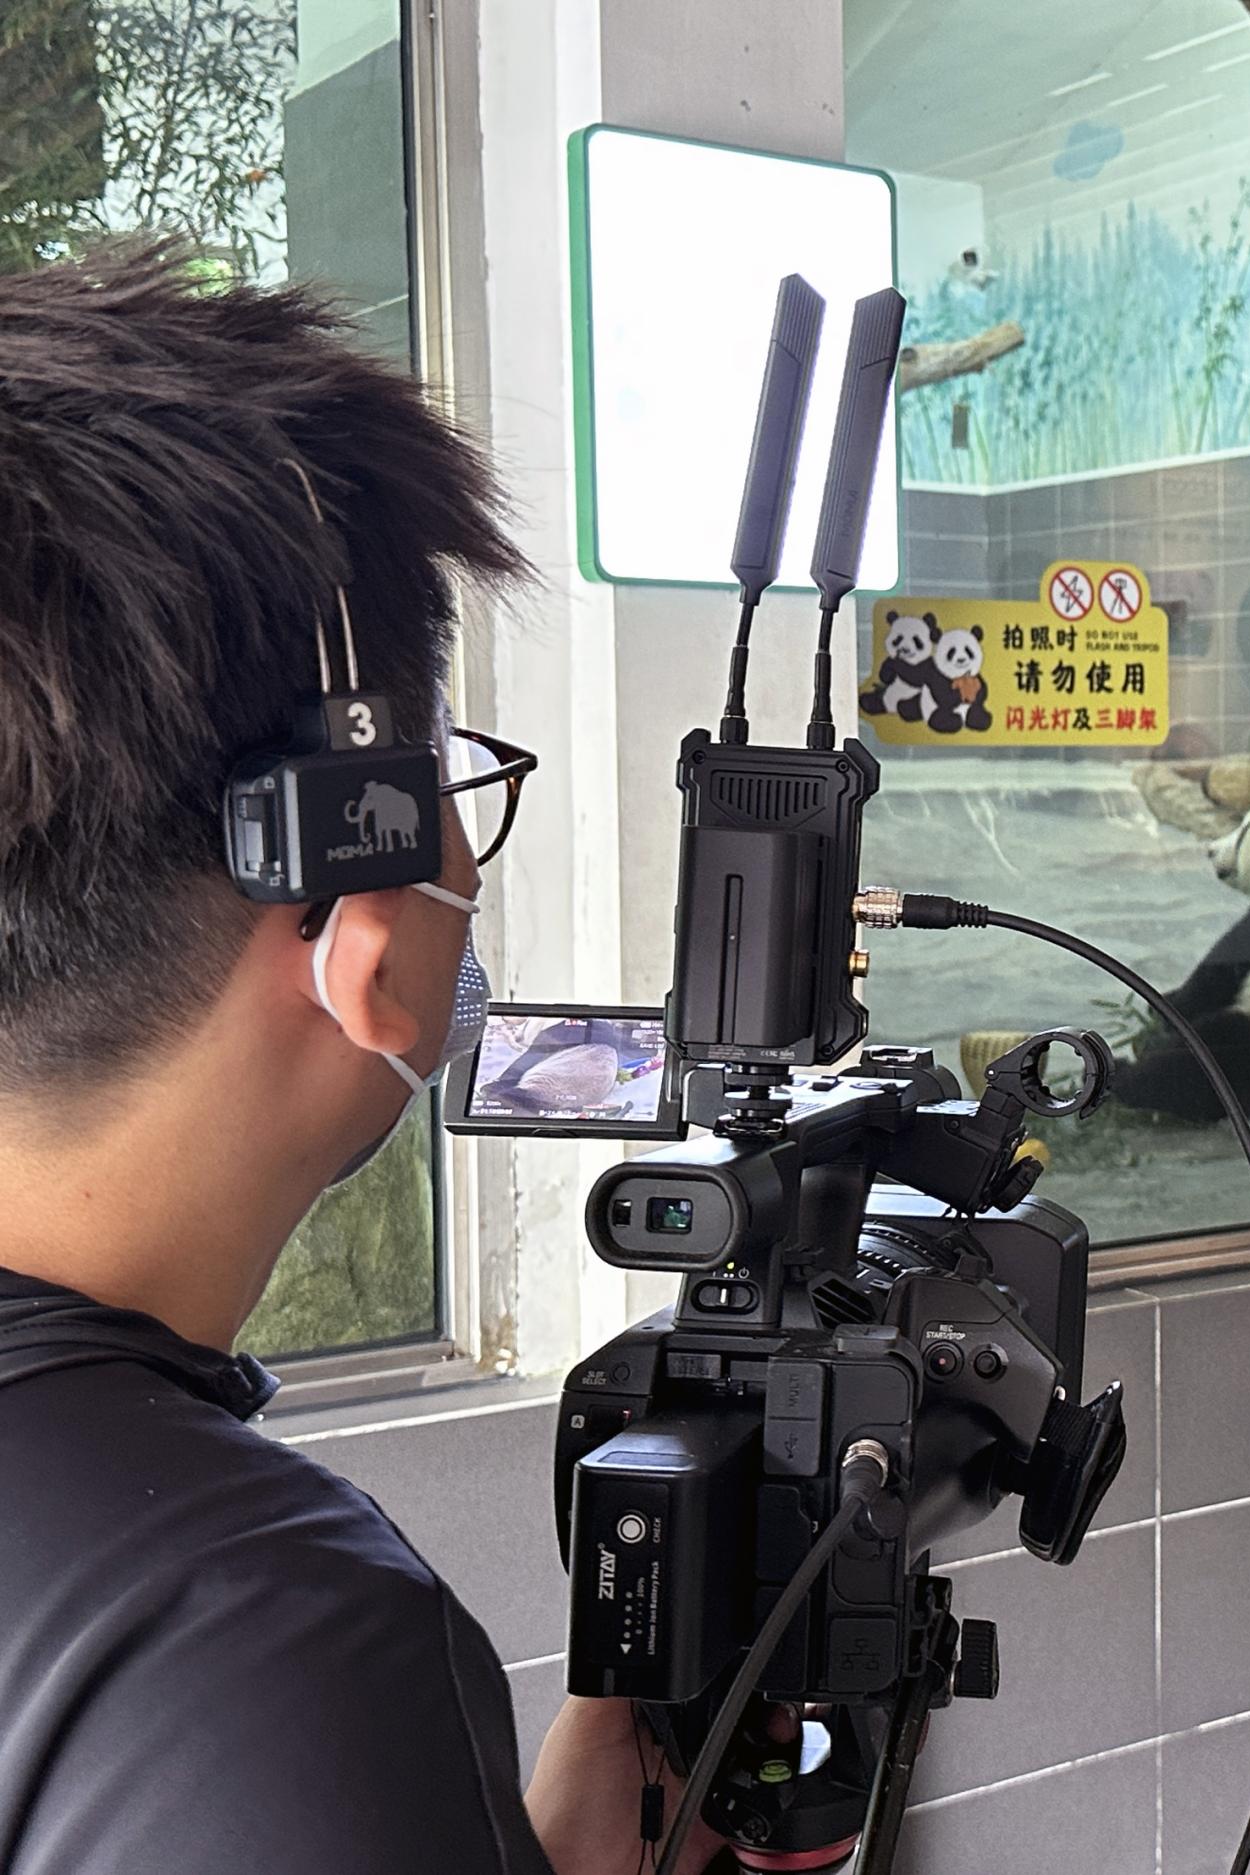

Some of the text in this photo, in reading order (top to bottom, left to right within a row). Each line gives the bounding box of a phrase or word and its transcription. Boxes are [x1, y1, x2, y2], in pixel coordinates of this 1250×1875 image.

[1003, 624, 1077, 652] 拍照时
[1014, 659, 1145, 694] 请勿使用
[348, 702, 376, 746] 3
[1006, 705, 1158, 731] 闪光灯及三脚架
[598, 1550, 616, 1599] ZITAY
